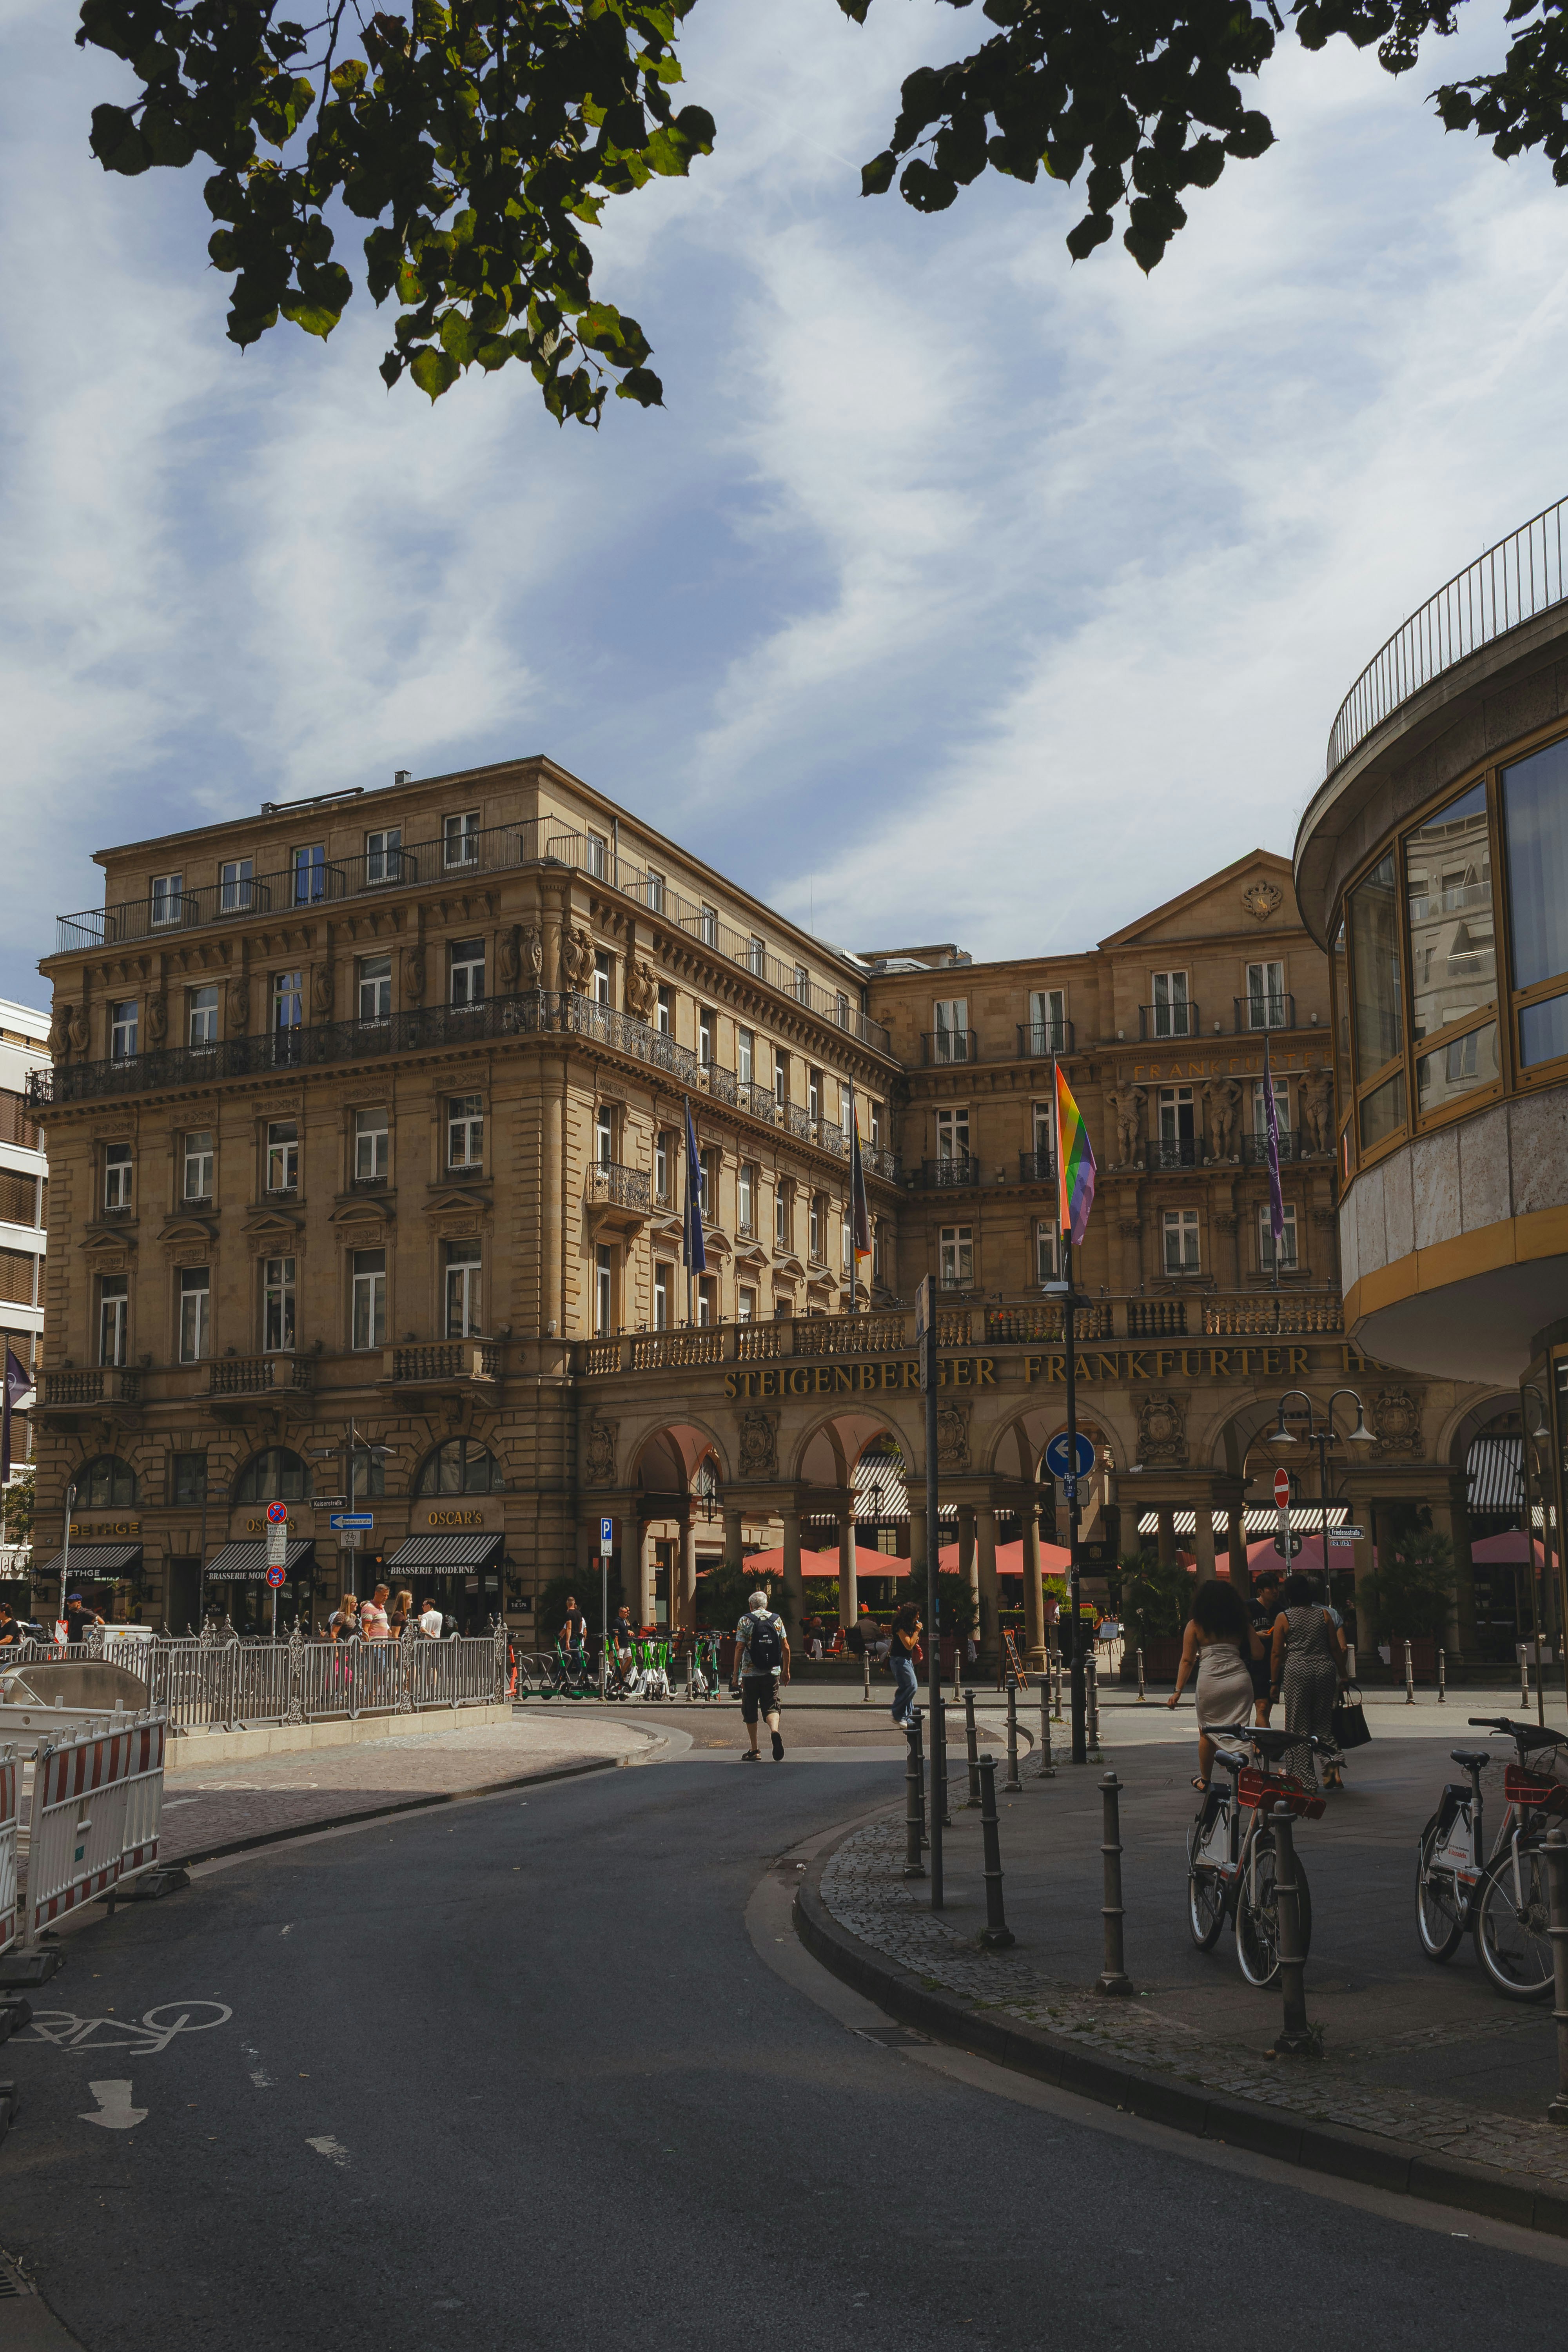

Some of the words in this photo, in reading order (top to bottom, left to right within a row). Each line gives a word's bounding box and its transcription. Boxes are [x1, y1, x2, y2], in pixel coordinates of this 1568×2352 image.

[1024, 1347, 1310, 1383] FRANKFURTER
[247, 1517, 294, 1531] OSC's
[428, 1510, 482, 1525] OSCAR's
[69, 1523, 140, 1536] BETHGE
[604, 1521, 610, 1537] P
[391, 1566, 432, 1575] BRASSERIE
[434, 1566, 475, 1574] MODERNE
